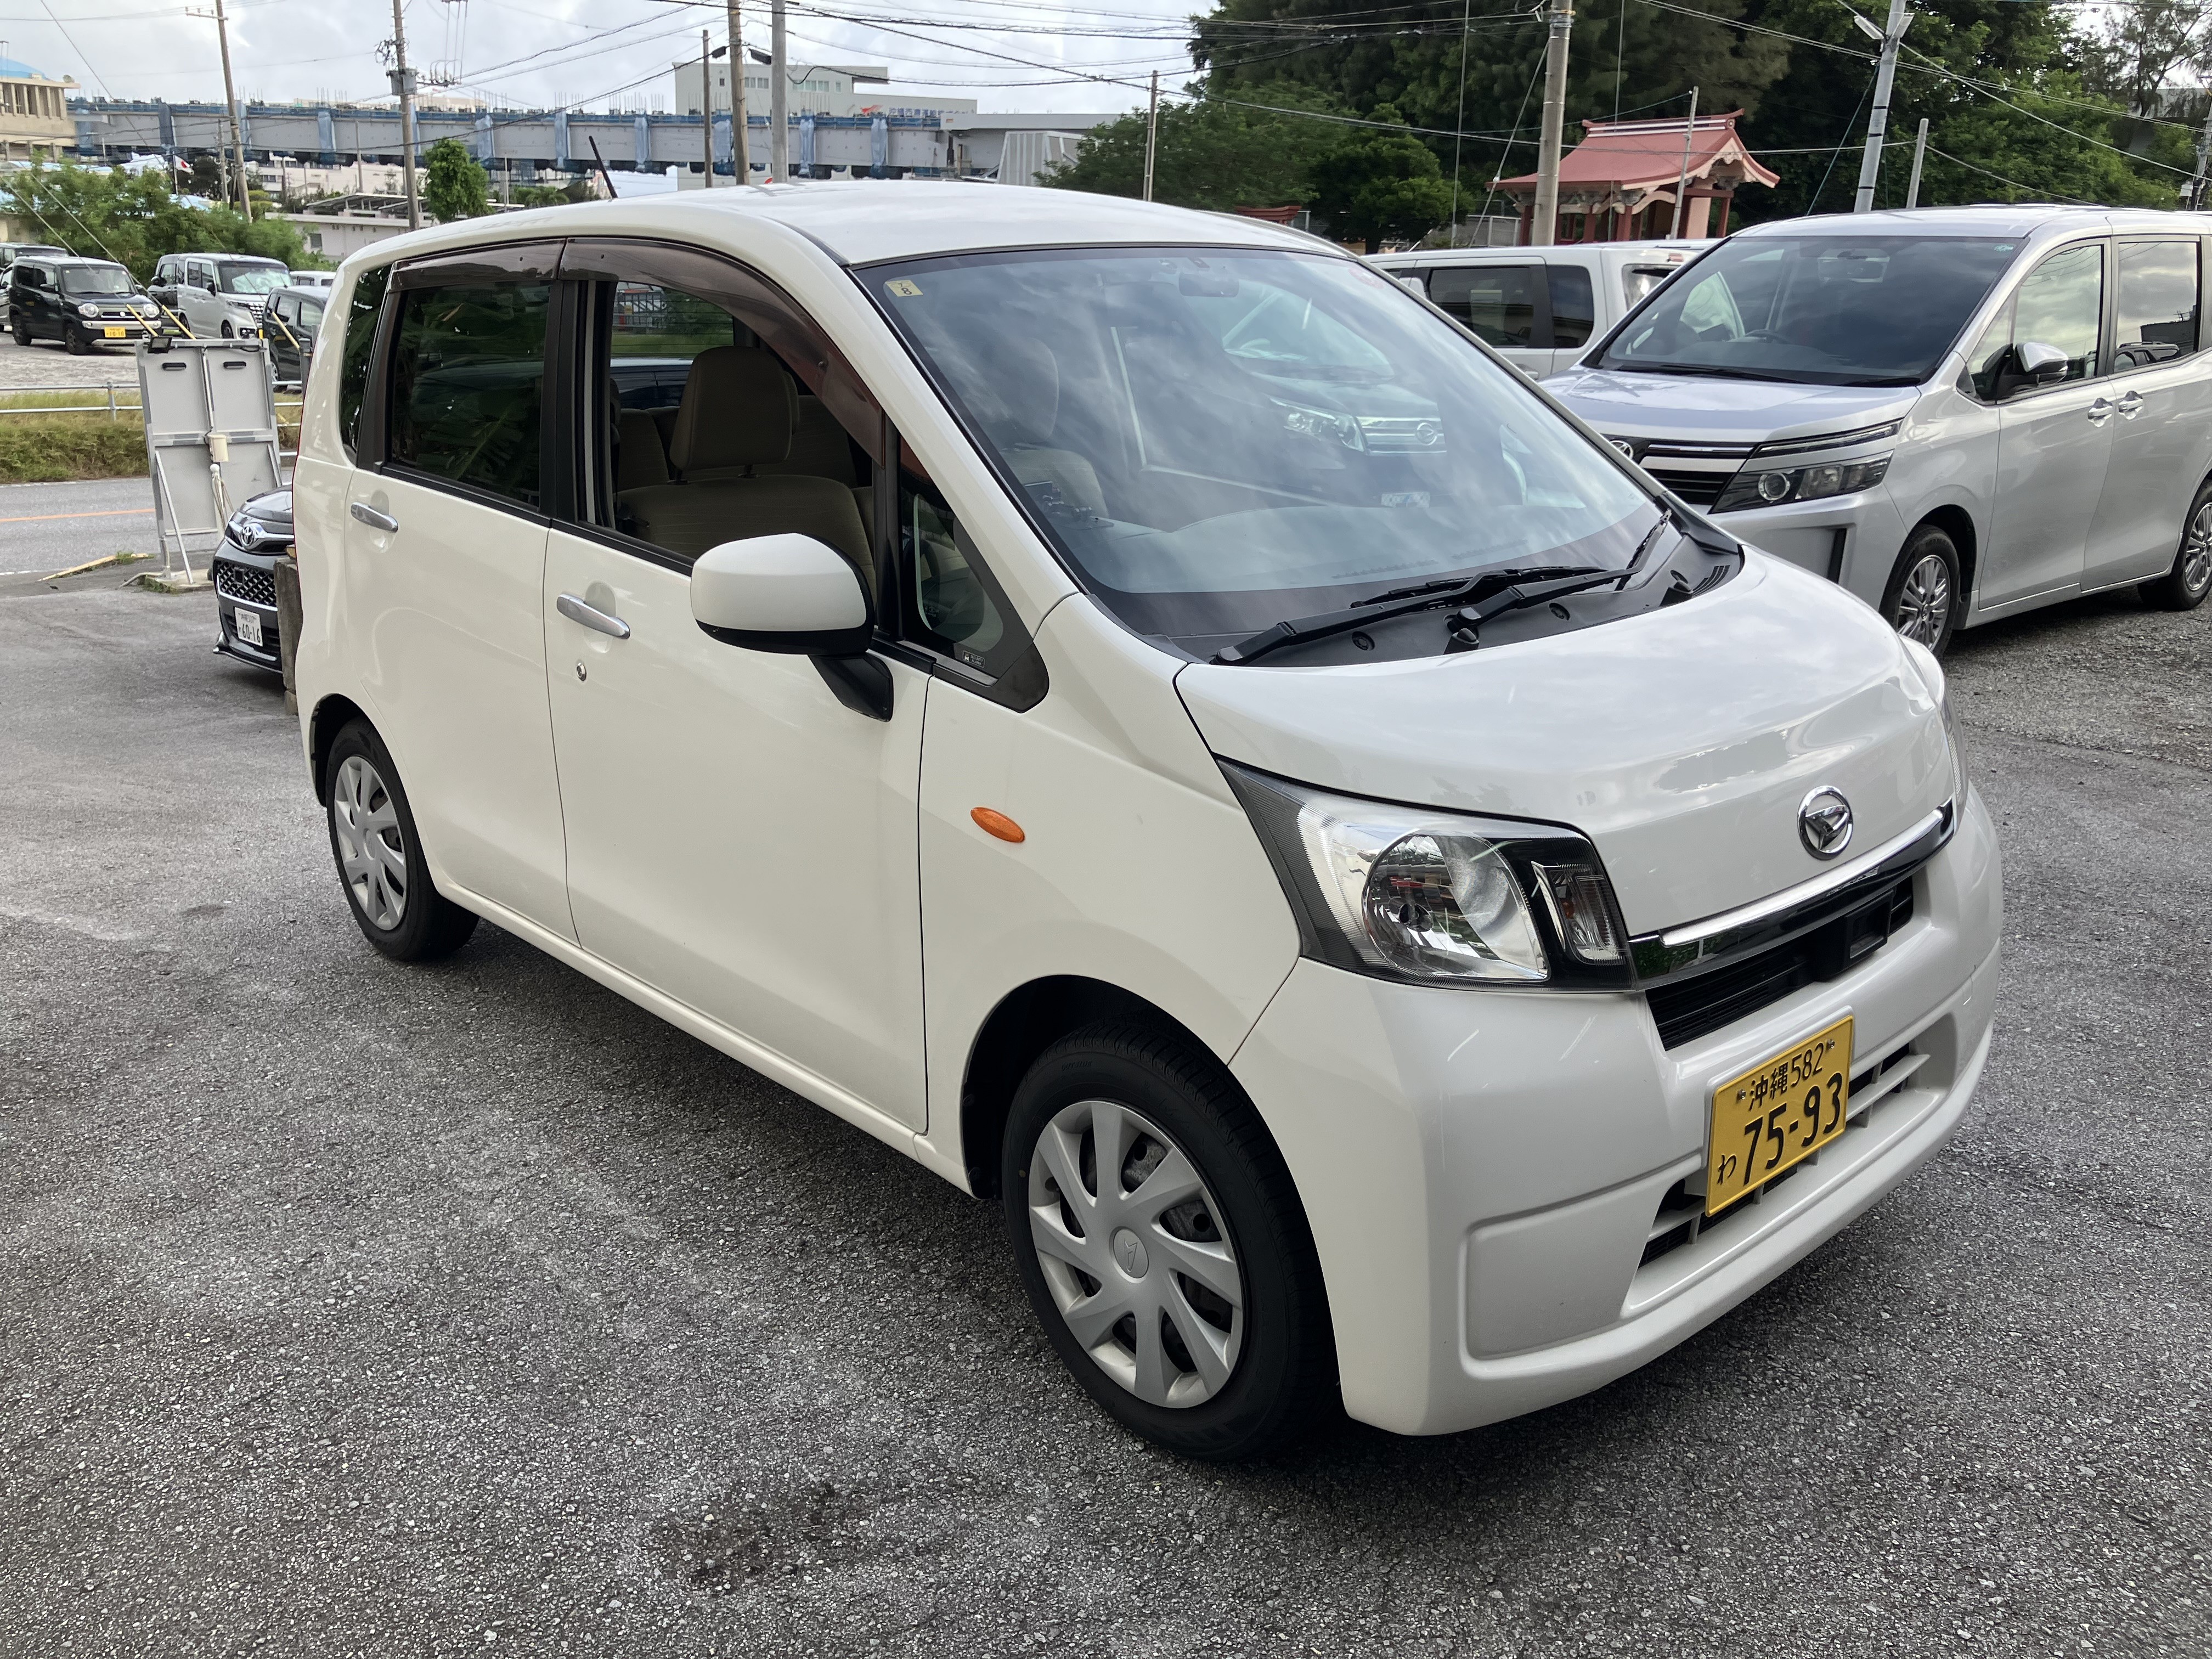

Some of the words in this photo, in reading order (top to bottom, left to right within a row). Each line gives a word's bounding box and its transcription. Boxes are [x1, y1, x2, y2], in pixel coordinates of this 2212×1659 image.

[242, 623, 261, 643] 60-16
[1748, 1042, 1825, 1112] 沖縄582
[1717, 1153, 1737, 1186] わ
[1743, 1071, 1843, 1186] 75-93
